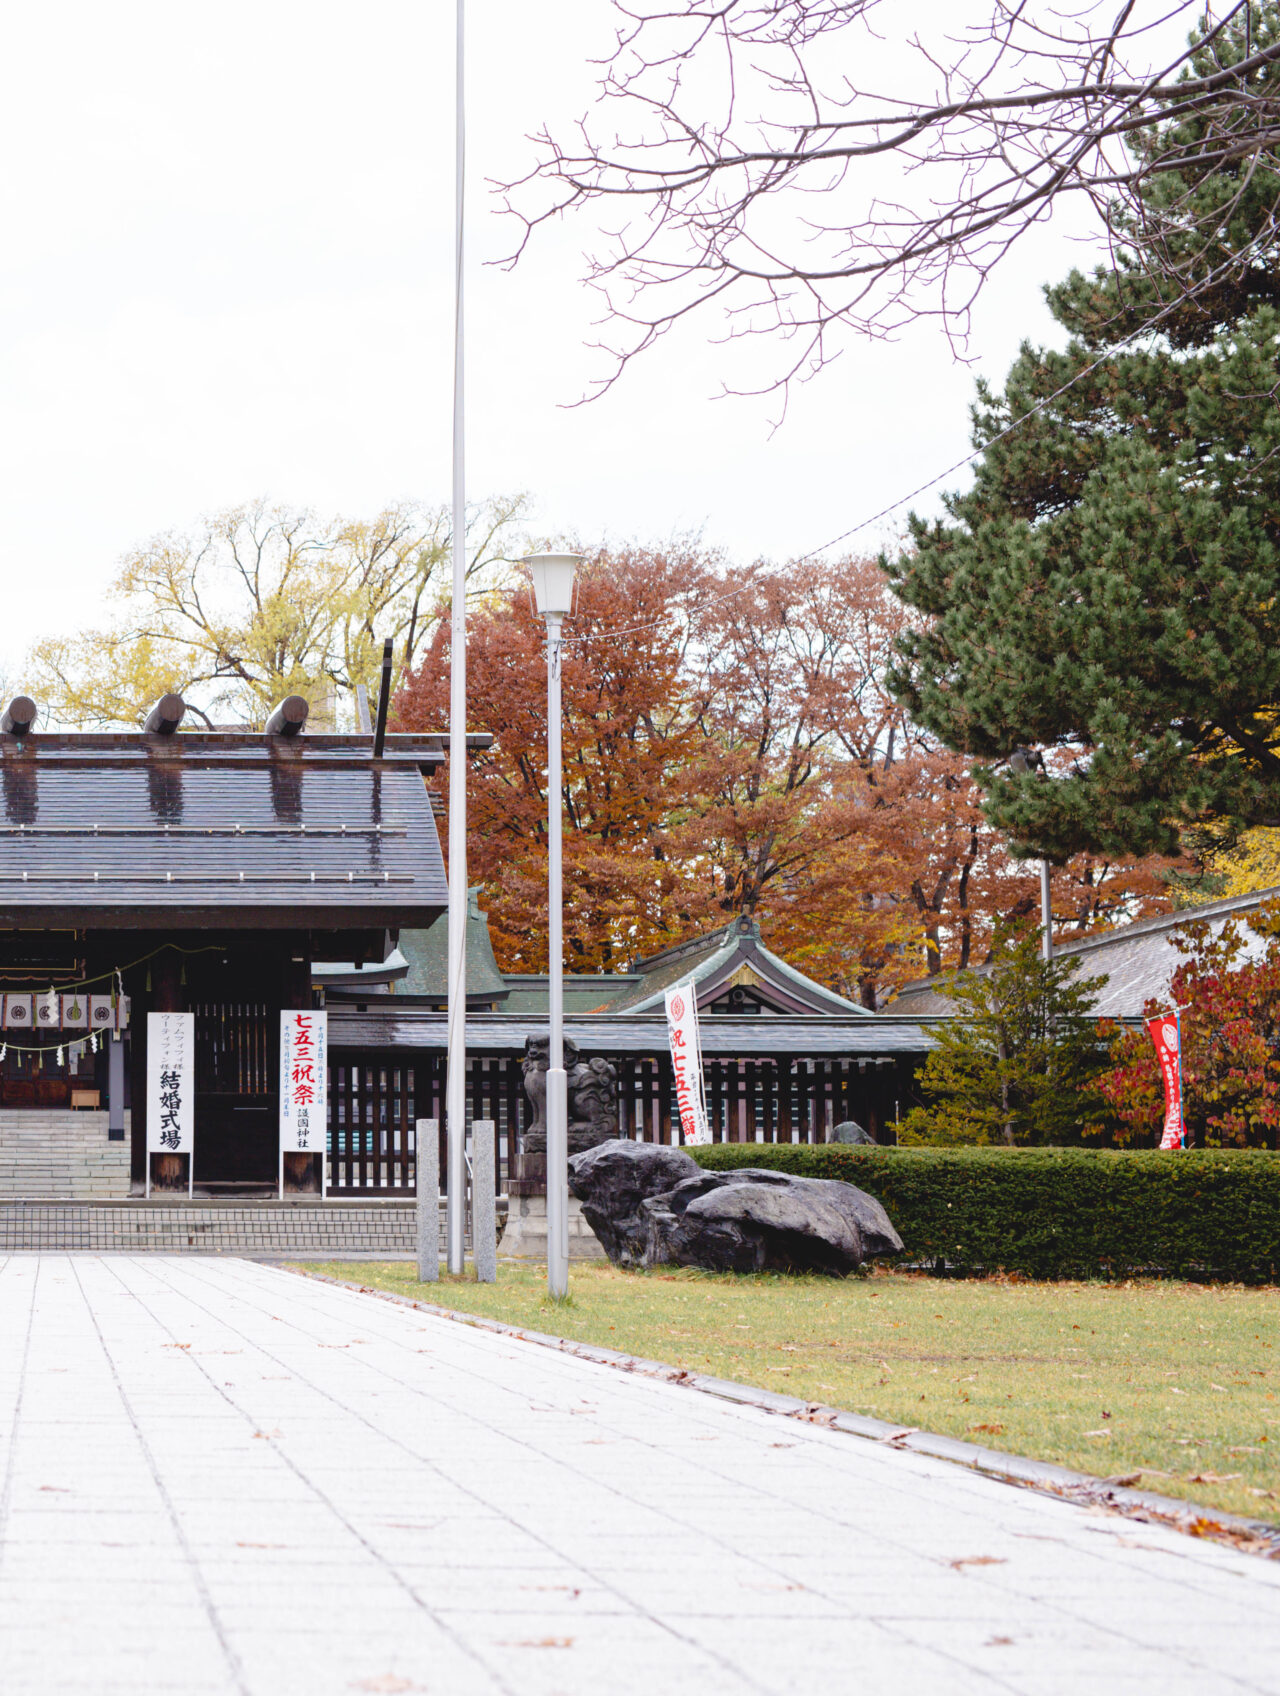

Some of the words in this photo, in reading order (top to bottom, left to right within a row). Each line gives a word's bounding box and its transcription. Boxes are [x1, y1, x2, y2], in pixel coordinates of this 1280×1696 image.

[291, 1014, 315, 1106] 七五三祝祭
[159, 1071, 182, 1150] 結婚式場
